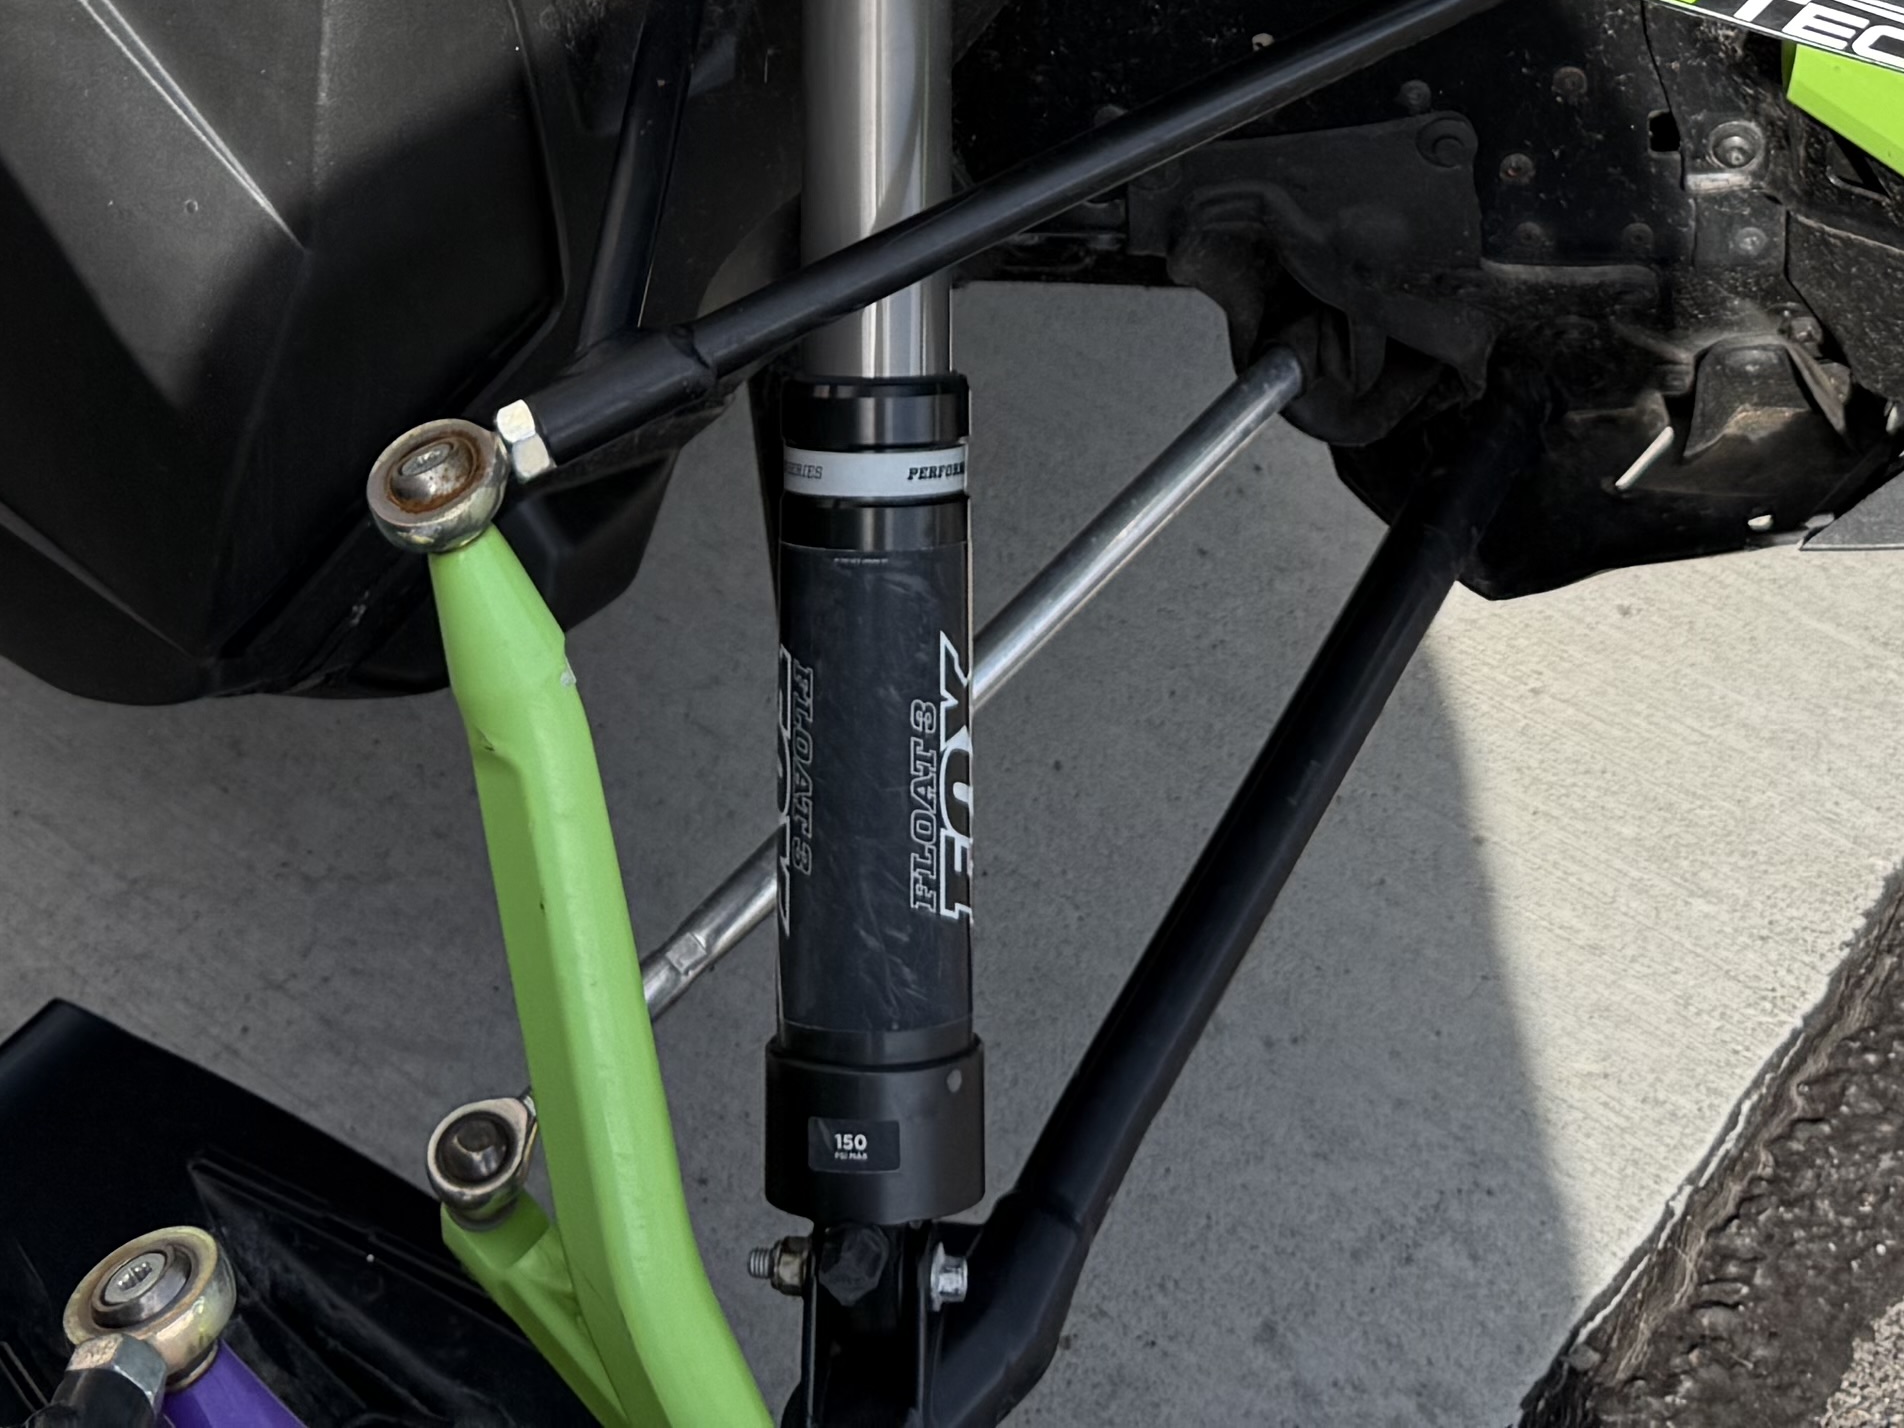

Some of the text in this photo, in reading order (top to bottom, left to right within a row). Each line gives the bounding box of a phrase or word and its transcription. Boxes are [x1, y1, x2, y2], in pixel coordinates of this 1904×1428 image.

[792, 659, 814, 876] FLOAT 3
[910, 698, 938, 914] FLOAT 3
[834, 1132, 868, 1151] 150
